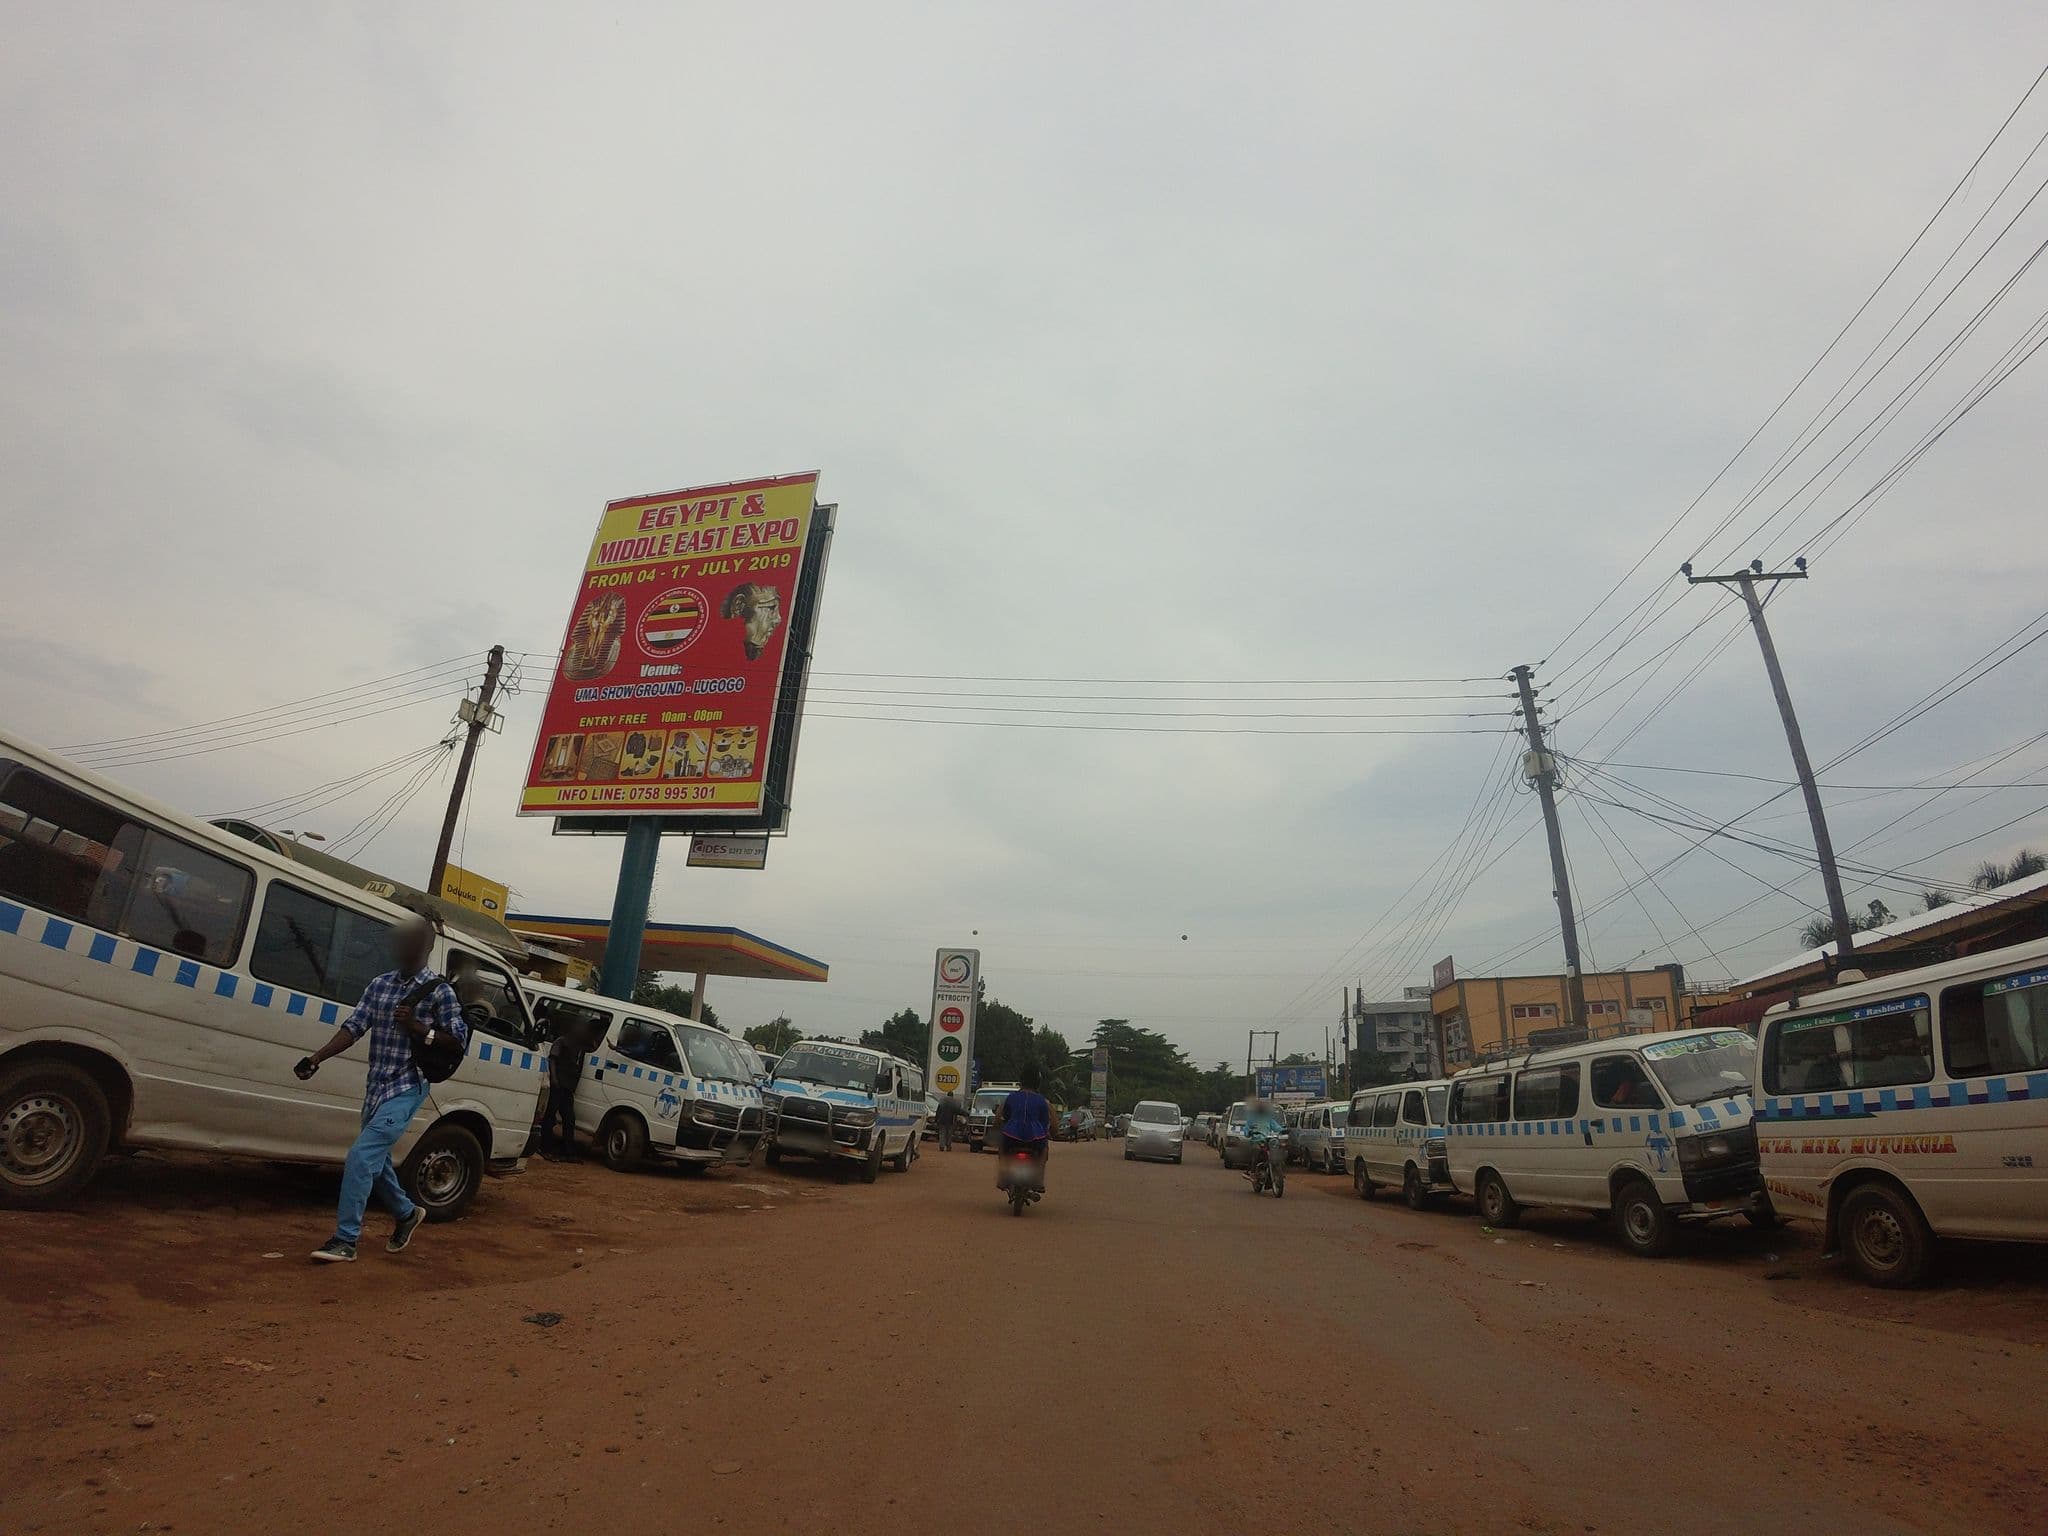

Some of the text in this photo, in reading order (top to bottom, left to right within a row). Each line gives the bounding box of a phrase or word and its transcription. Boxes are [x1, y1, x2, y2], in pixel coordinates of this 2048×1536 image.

[637, 494, 765, 532] EGYPT &
[596, 517, 800, 567] MIDDLE EAST EXPO
[588, 570, 633, 590] FROM
[637, 568, 656, 583] 04
[671, 564, 690, 580] 17
[697, 558, 745, 577] JULY
[748, 553, 791, 571] 2019
[640, 663, 683, 677] Venue:
[575, 687, 598, 703] UMA
[692, 677, 746, 695] LUGOGO
[579, 715, 616, 727] ENTRY
[619, 713, 648, 725] FREE
[661, 711, 687, 723] 10am
[693, 709, 723, 722] 08pm
[557, 786, 716, 801] INFO LINE: 0758 995 301
[368, 881, 387, 894] TAXI
[937, 993, 970, 1003] PETROCITY
[1866, 1002, 1906, 1016] Rashford
[1850, 1135, 1958, 1154] MUTUKULA
